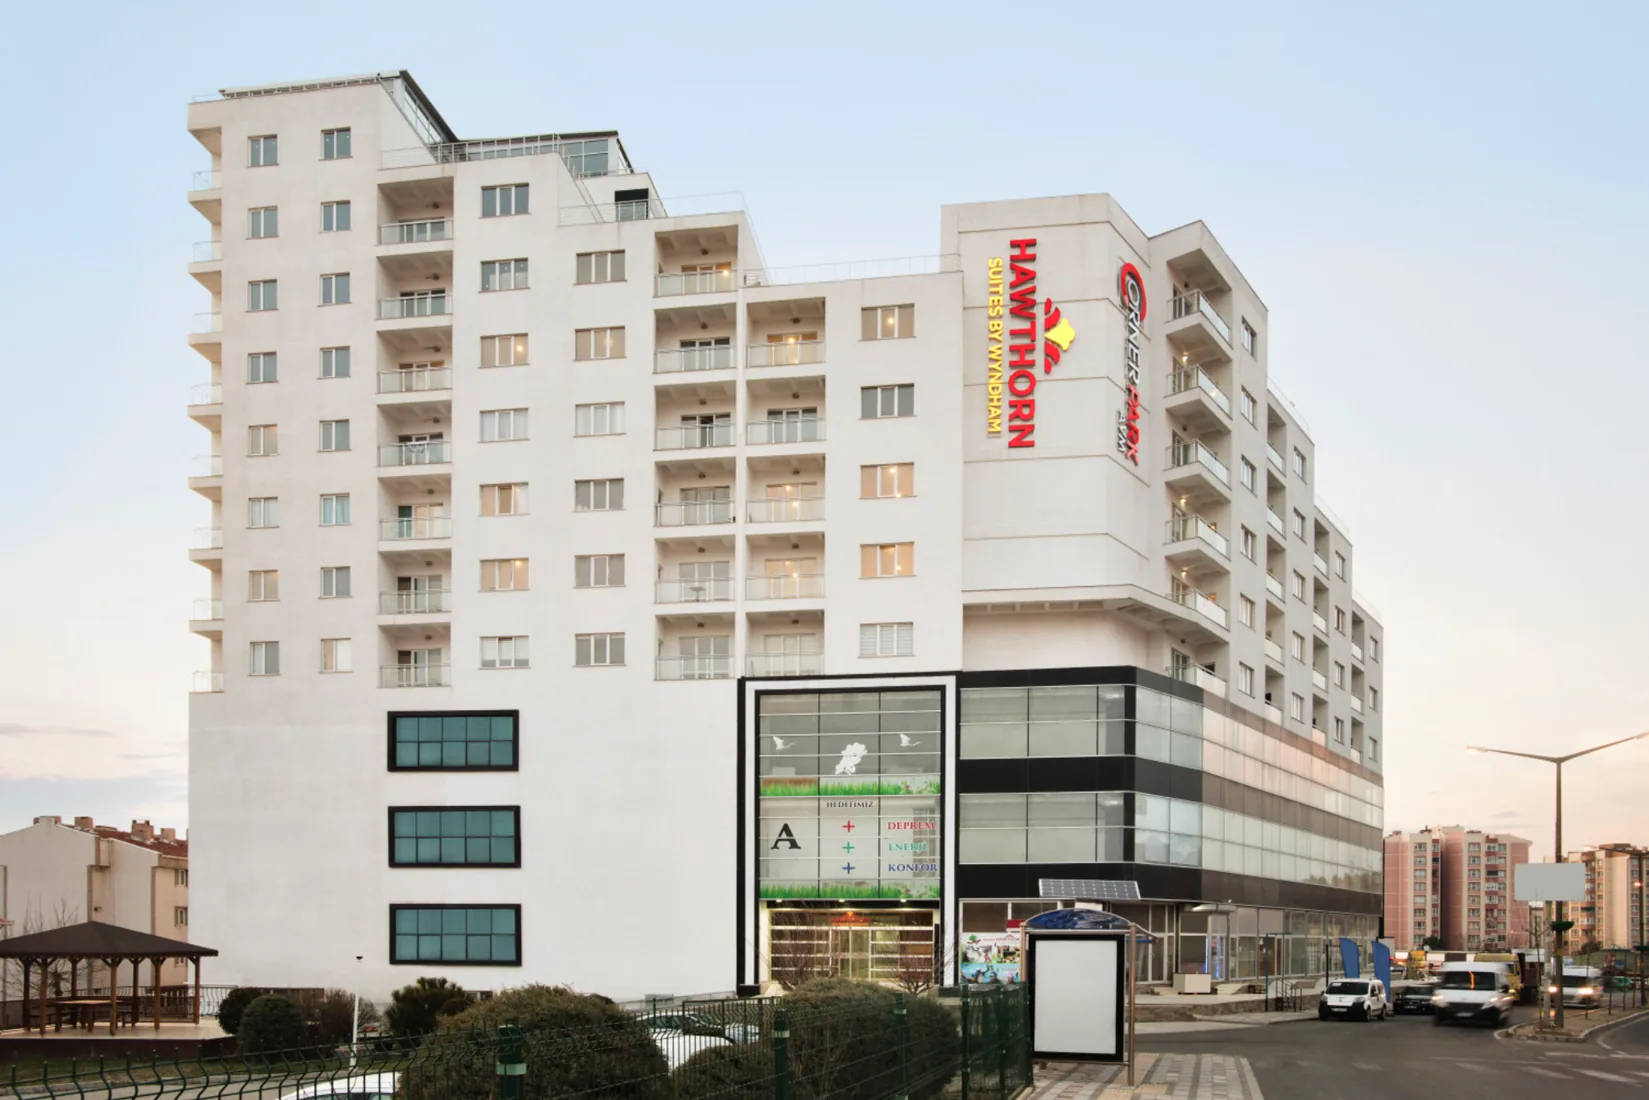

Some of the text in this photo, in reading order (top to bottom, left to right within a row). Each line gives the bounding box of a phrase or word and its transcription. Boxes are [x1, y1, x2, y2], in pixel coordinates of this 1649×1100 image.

[987, 257, 1003, 435] SUITES BY WYNDHAM
[1008, 238, 1036, 449] HAWTHORN
[1118, 262, 1147, 467] CORNER PARK
[770, 823, 802, 850] A
[887, 821, 935, 830] DEPREM
[888, 863, 938, 872] KONFOR
